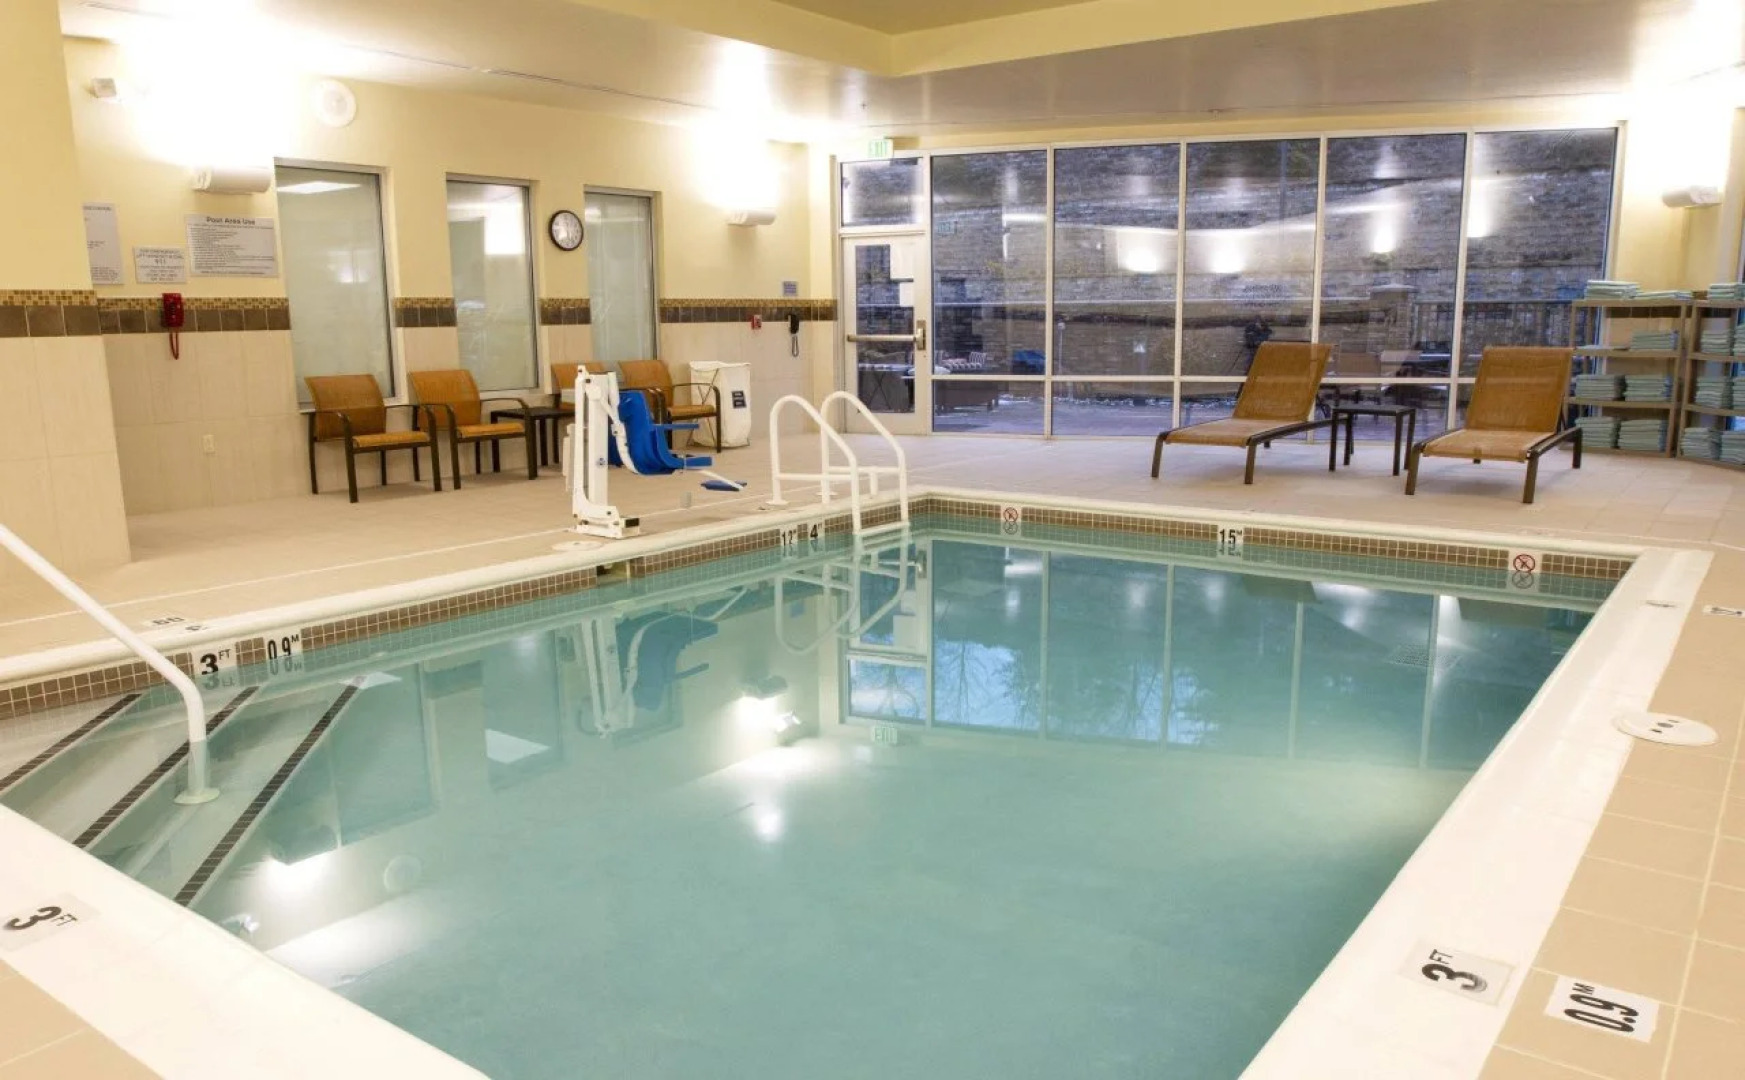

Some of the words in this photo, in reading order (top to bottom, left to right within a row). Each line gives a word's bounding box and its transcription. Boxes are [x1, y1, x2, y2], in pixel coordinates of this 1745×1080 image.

[810, 524, 819, 538] 4
[200, 652, 219, 675] 3
[3, 906, 62, 930] 3
[1421, 963, 1488, 993] 3
[1563, 992, 1640, 1033] 0.9
